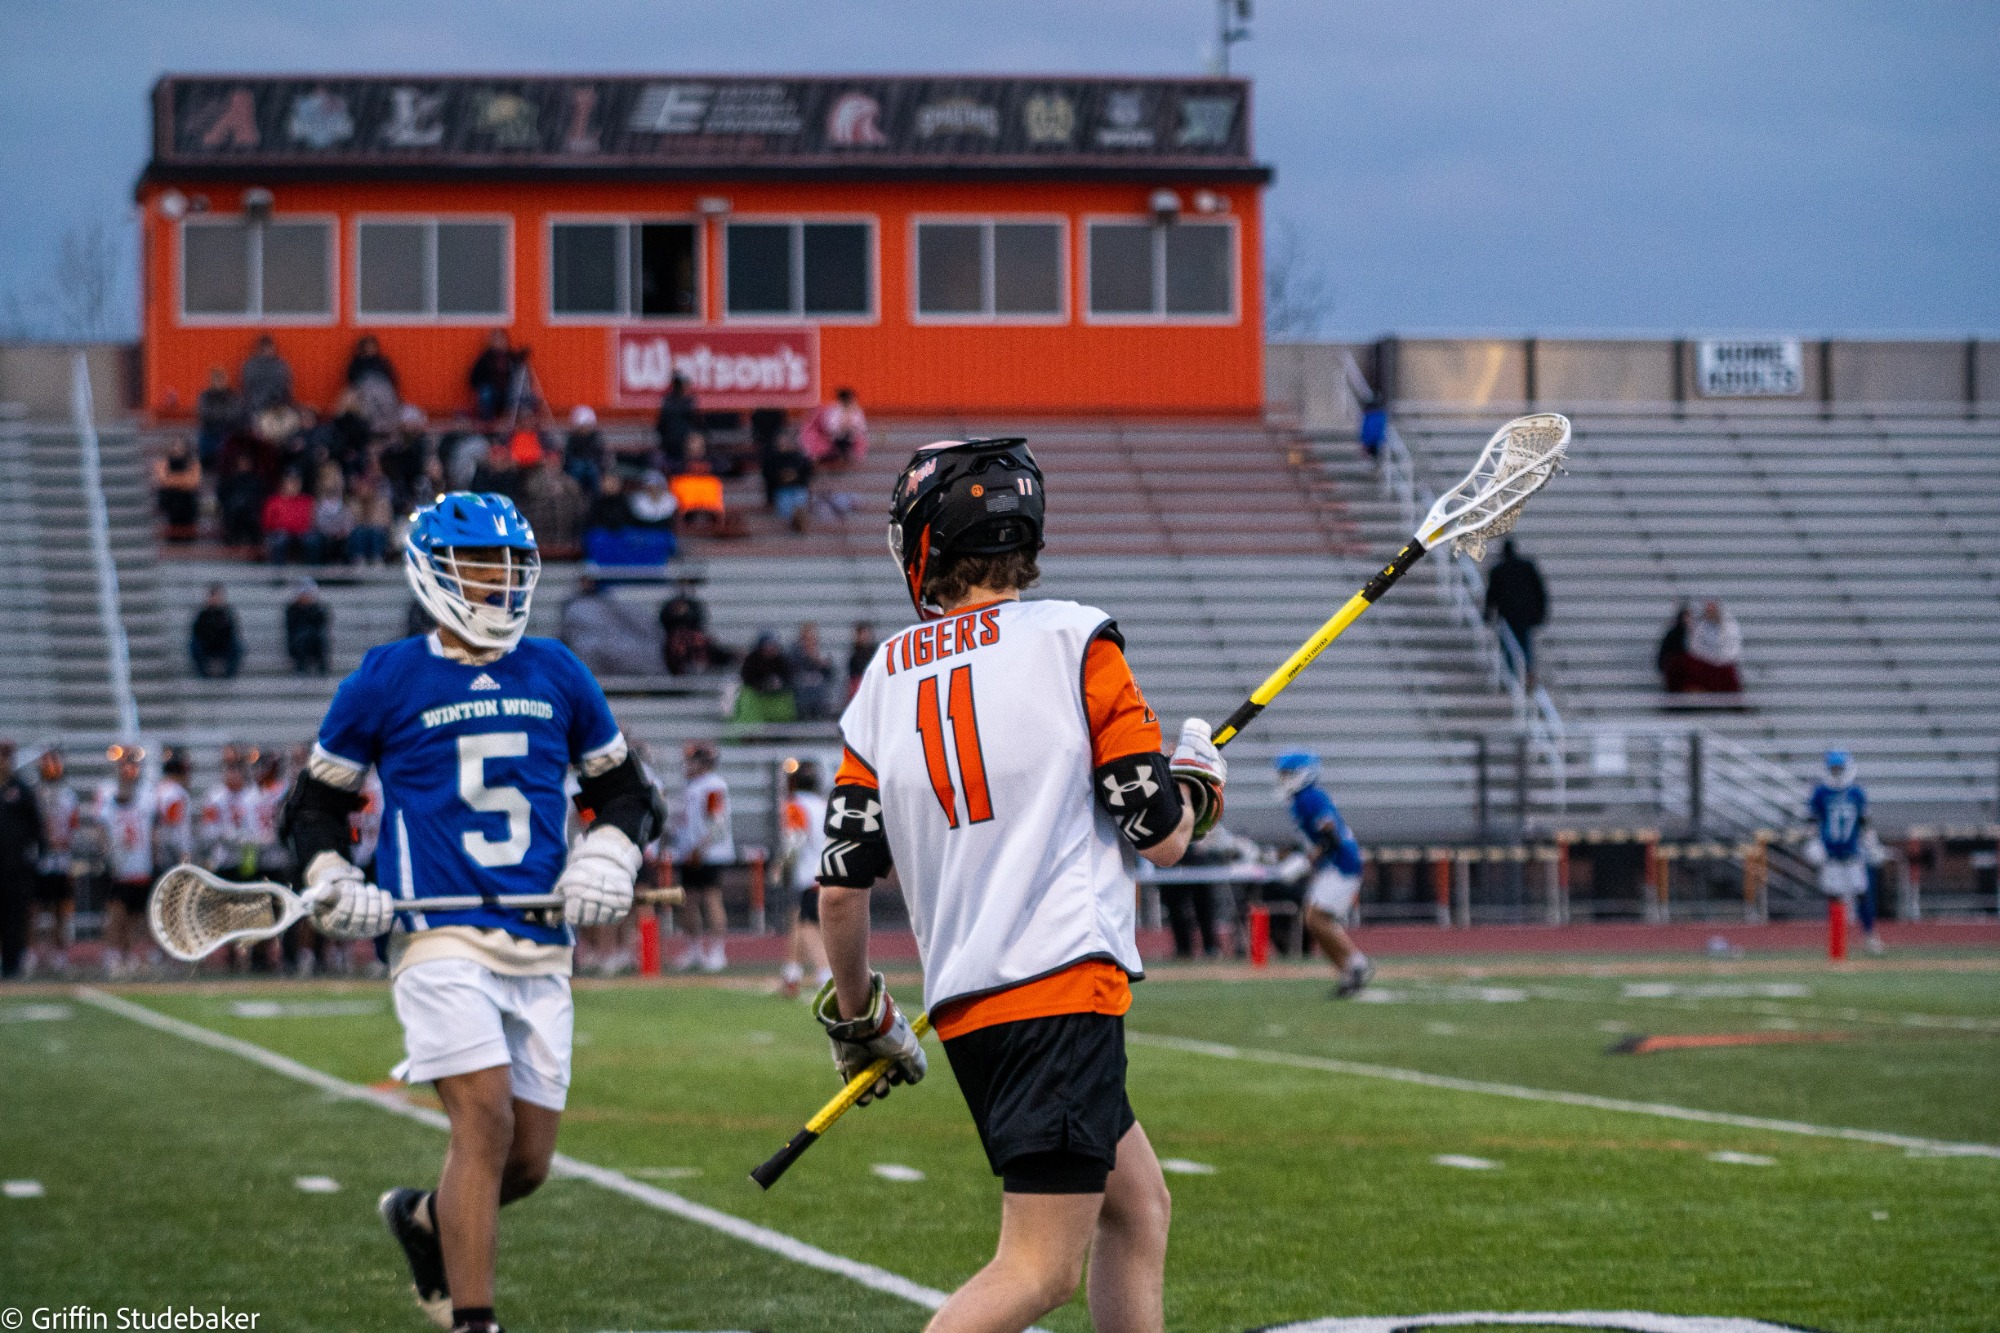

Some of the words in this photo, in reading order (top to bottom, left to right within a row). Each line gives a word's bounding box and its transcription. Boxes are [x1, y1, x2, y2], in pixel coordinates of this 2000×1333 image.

[1017, 478, 1033, 496] 11
[886, 608, 1000, 676] TIGERS
[422, 700, 499, 729] WINTON
[501, 698, 553, 720] WOODS
[916, 663, 995, 830] 11
[457, 731, 532, 868] 5
